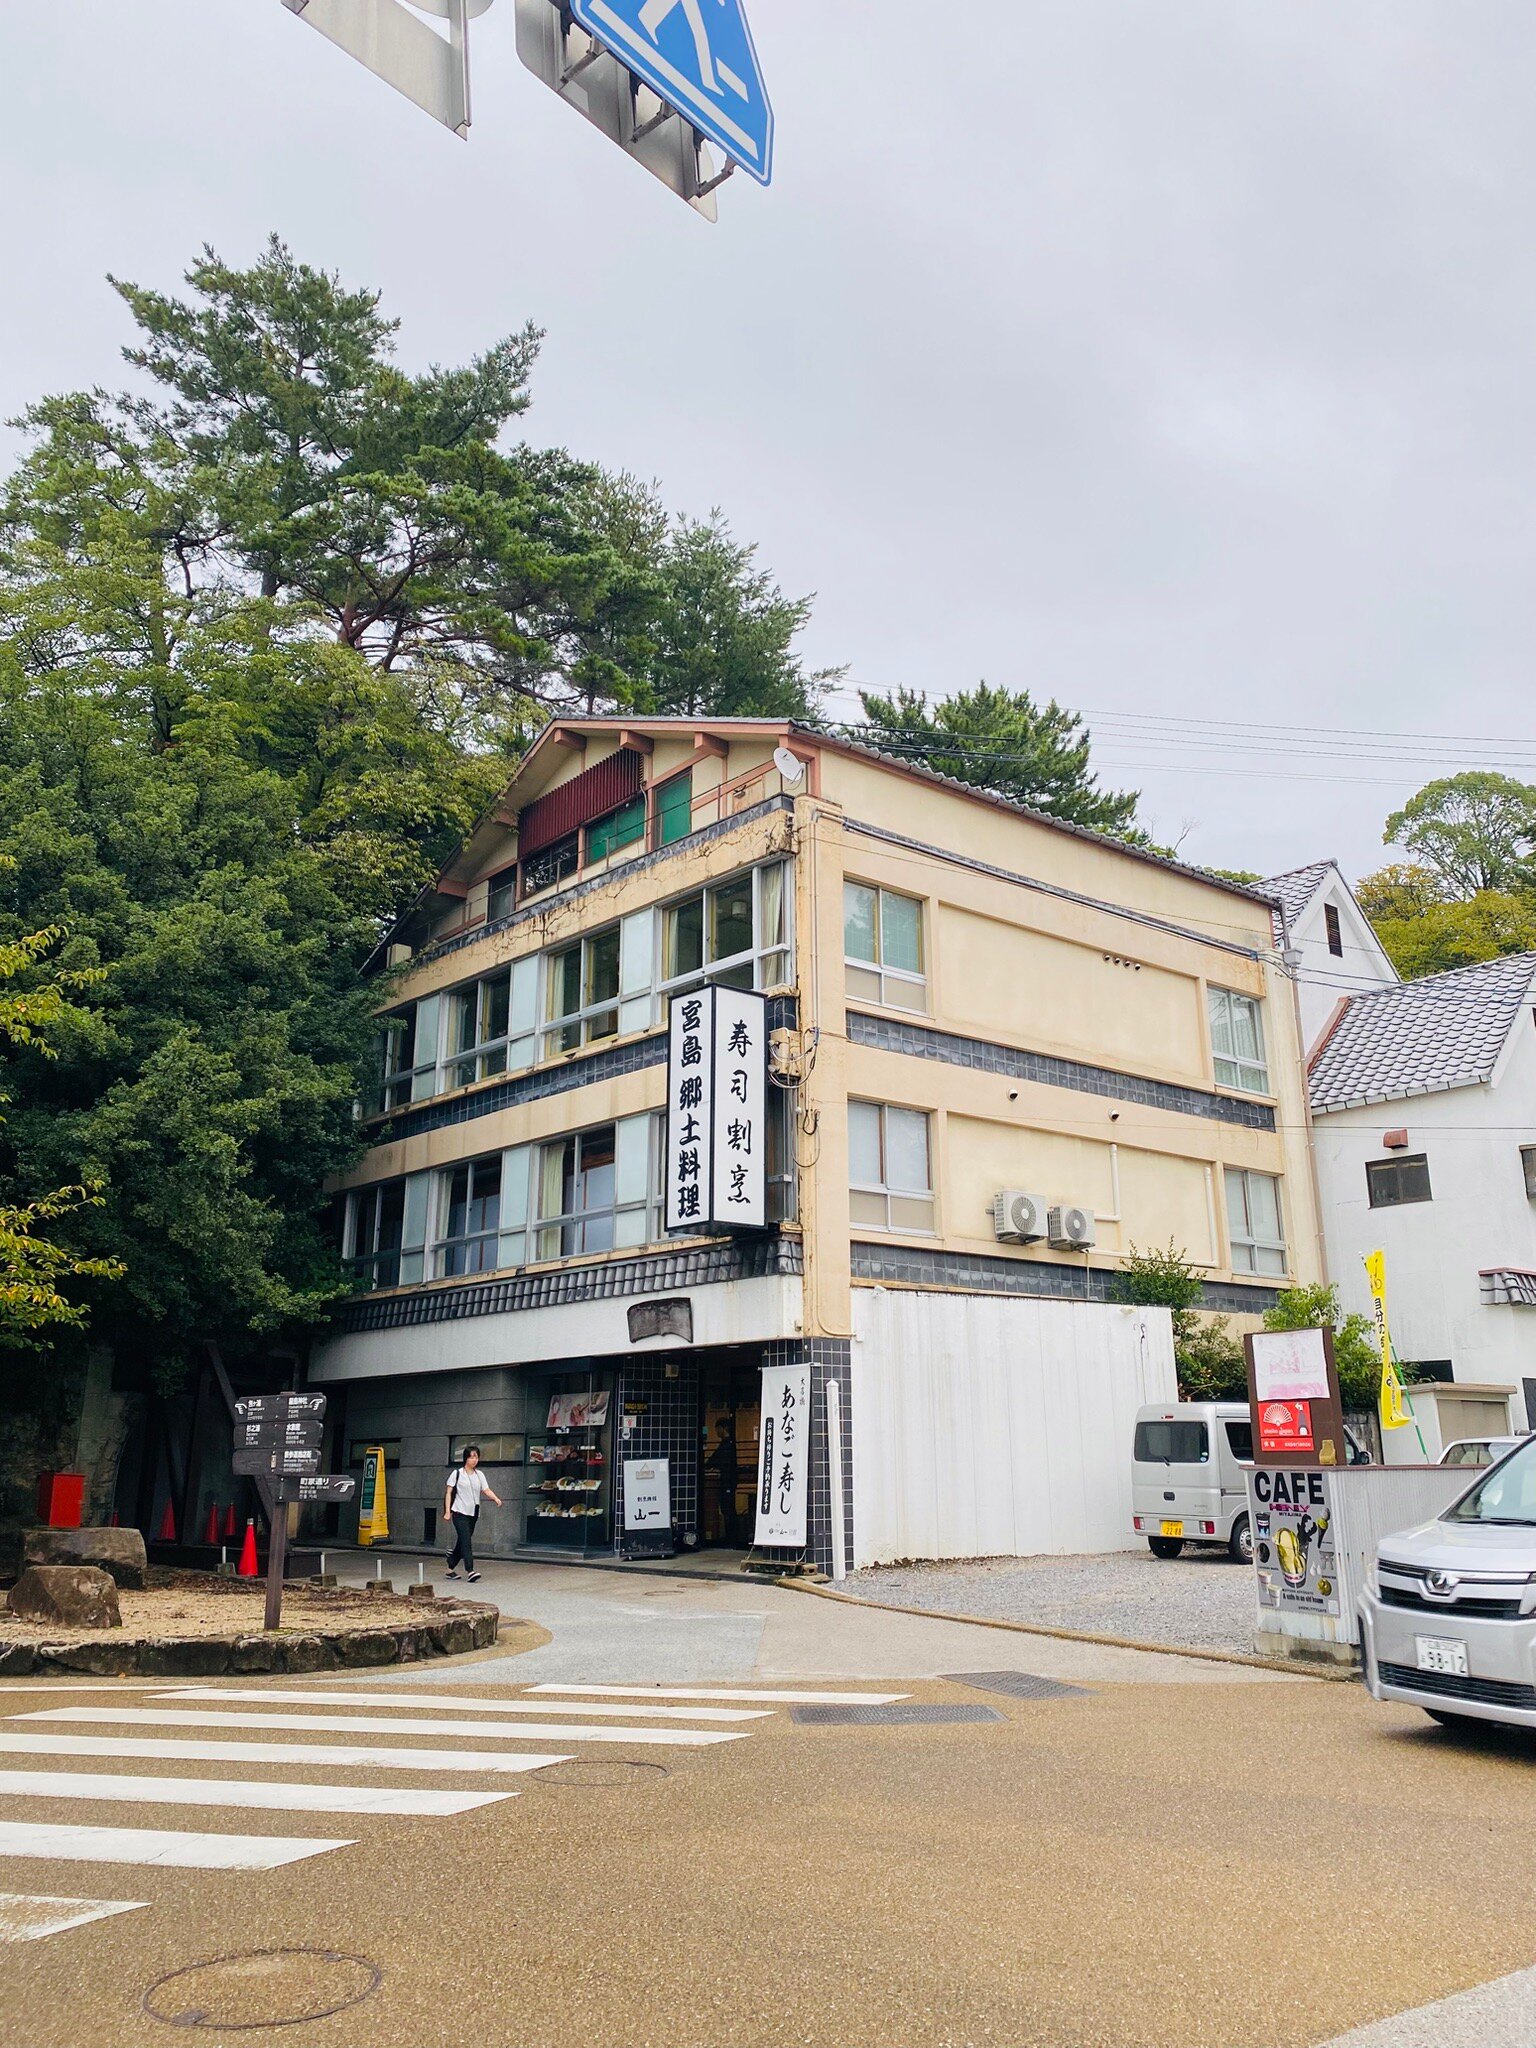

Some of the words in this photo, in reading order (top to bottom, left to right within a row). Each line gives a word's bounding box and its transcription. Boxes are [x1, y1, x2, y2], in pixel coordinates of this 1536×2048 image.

[678, 999, 703, 1219] 宮島郷土料理
[727, 1019, 753, 1204] 寿司割烹
[634, 1508, 660, 1521] 山一
[778, 1384, 796, 1515] あなご寿し
[1254, 1471, 1325, 1505] CAFE
